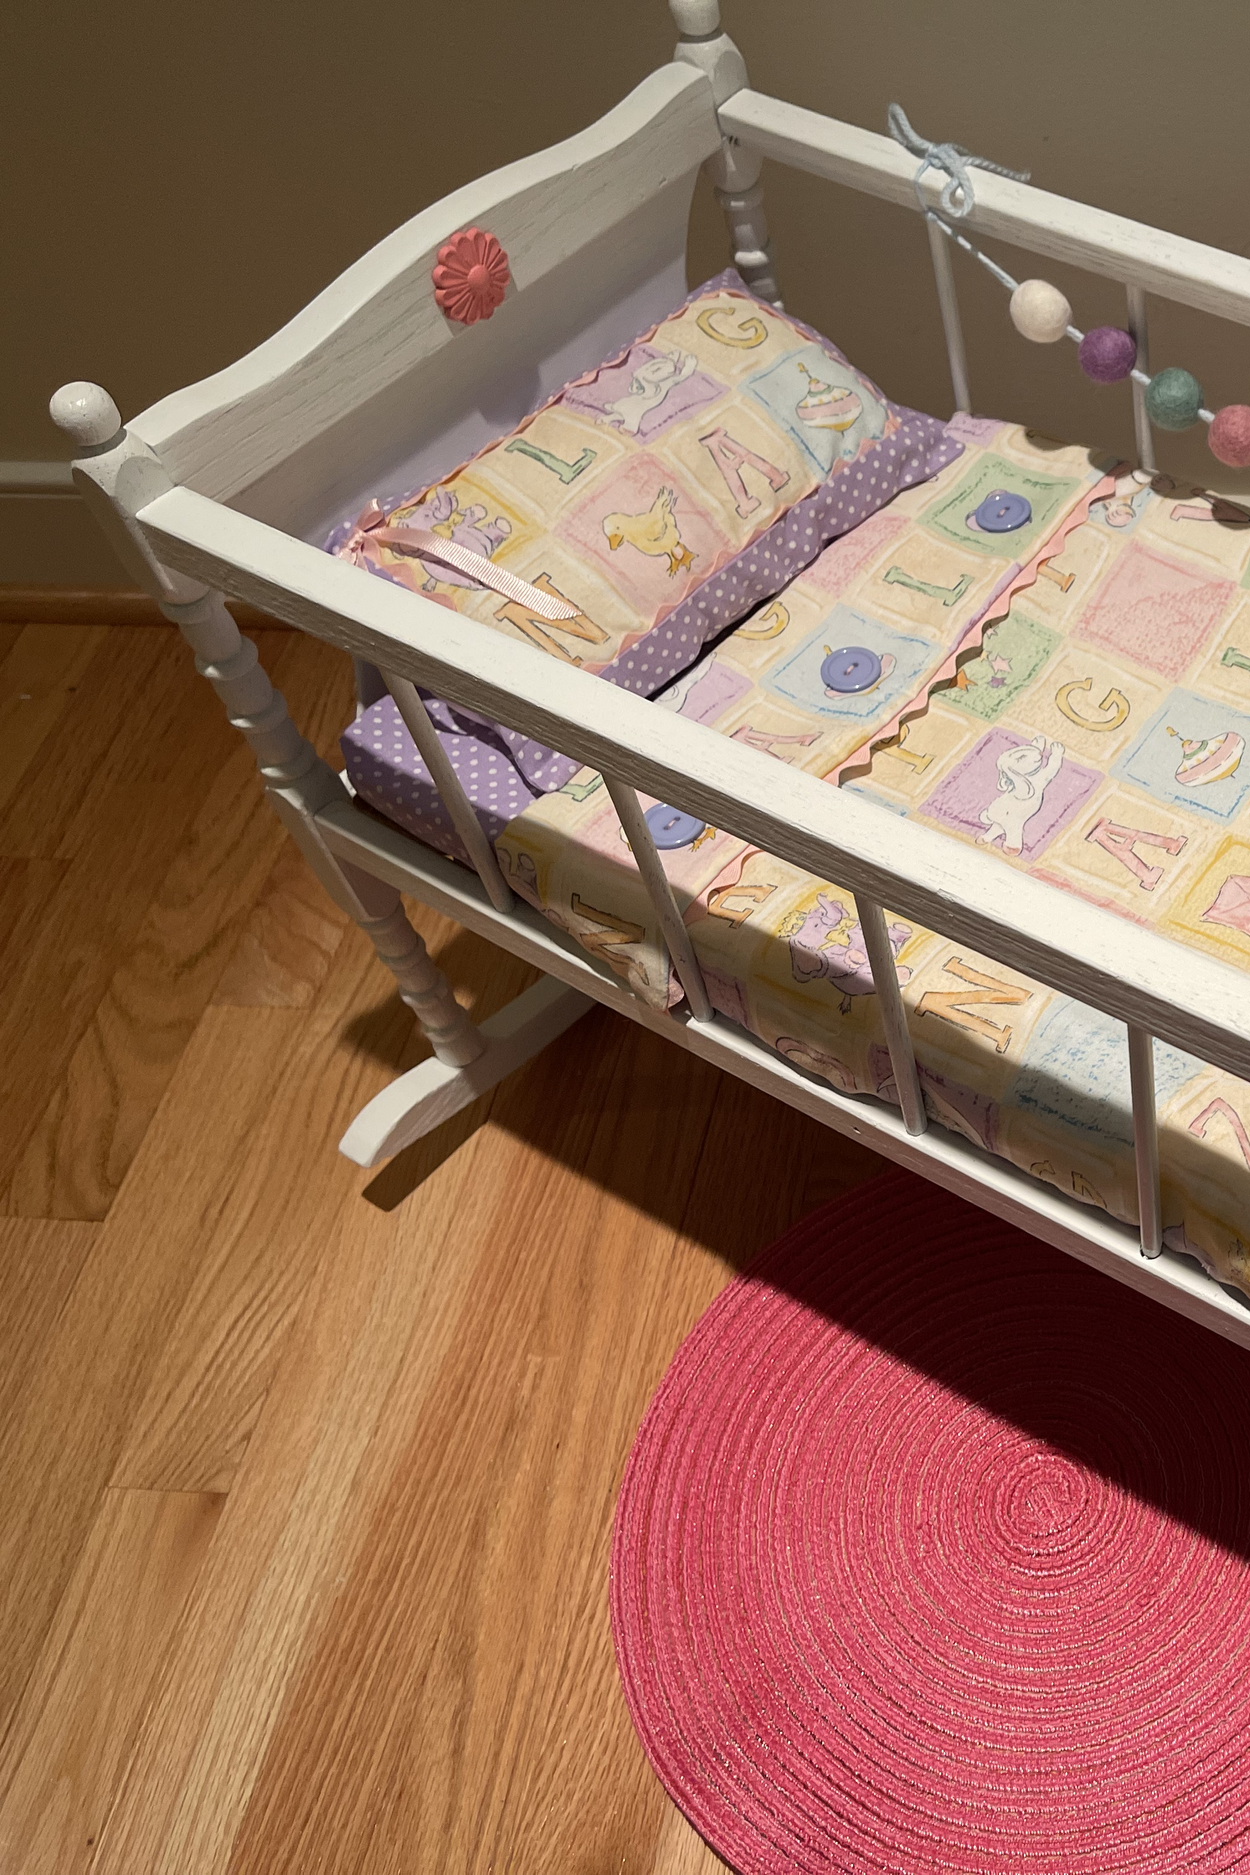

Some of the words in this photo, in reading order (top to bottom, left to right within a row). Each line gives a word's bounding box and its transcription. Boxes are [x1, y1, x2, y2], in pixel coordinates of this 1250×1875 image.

[695, 305, 769, 350] G
[504, 438, 598, 484] L
[699, 426, 791, 519] A
[882, 565, 975, 607] L
[1055, 677, 1131, 732] G
[1085, 817, 1189, 892] A
[914, 956, 1034, 1054] N
